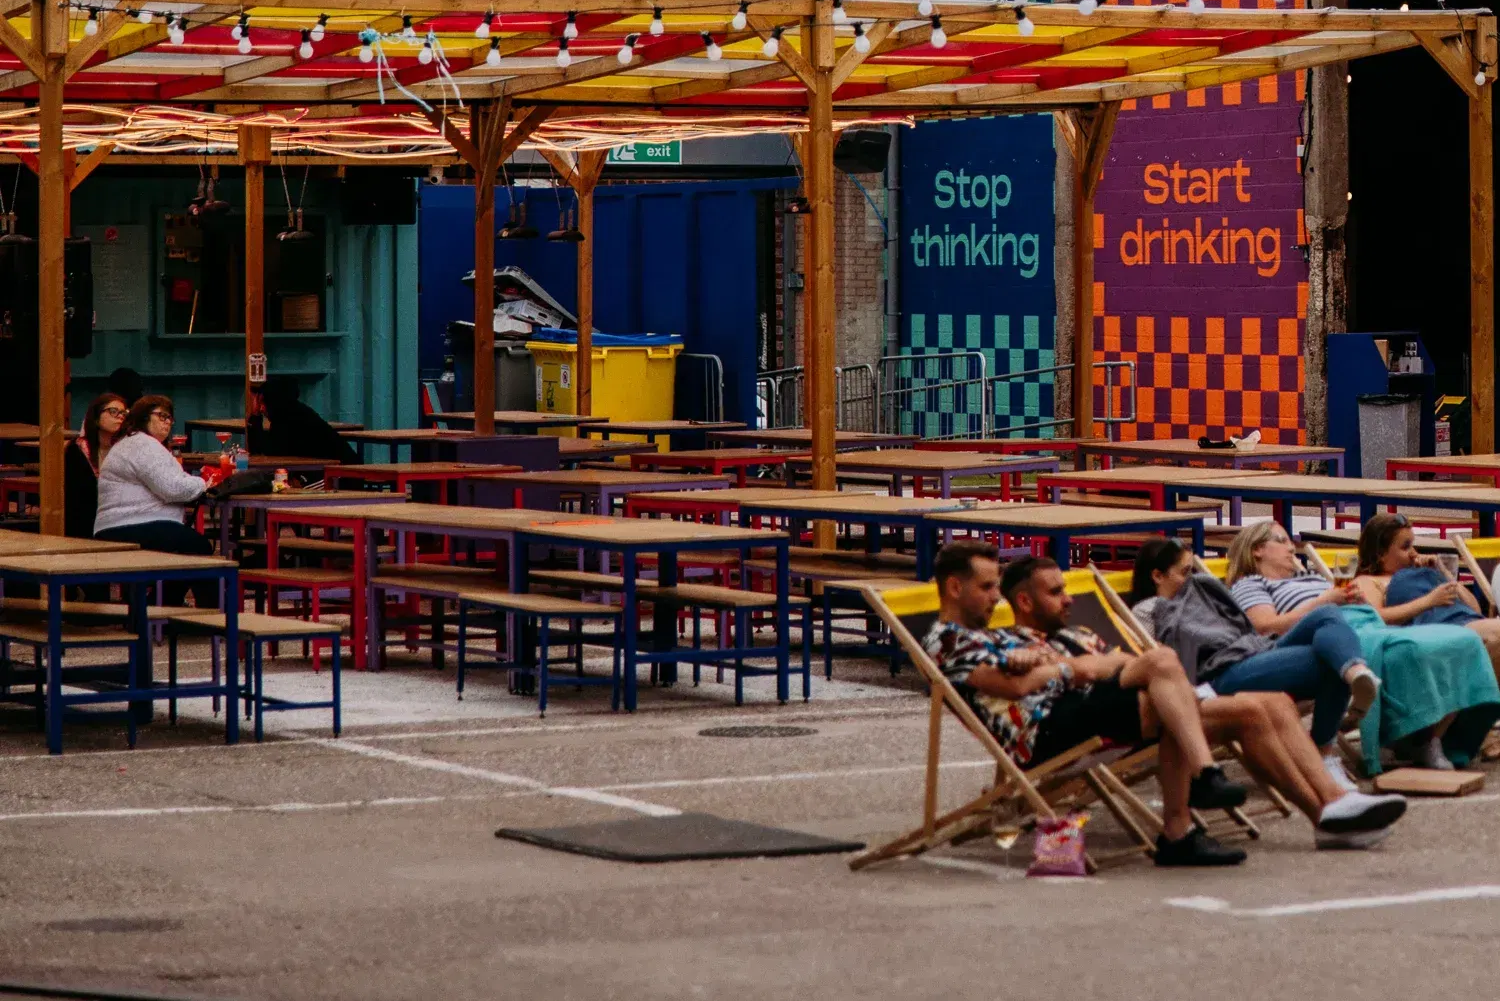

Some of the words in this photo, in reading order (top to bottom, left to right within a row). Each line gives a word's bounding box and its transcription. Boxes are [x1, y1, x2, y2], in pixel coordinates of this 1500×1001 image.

[646, 145, 671, 157] exit
[934, 169, 1012, 218] Stop
[1144, 158, 1251, 204] Start
[911, 223, 1039, 278] thinking
[1120, 217, 1281, 277] drinking
